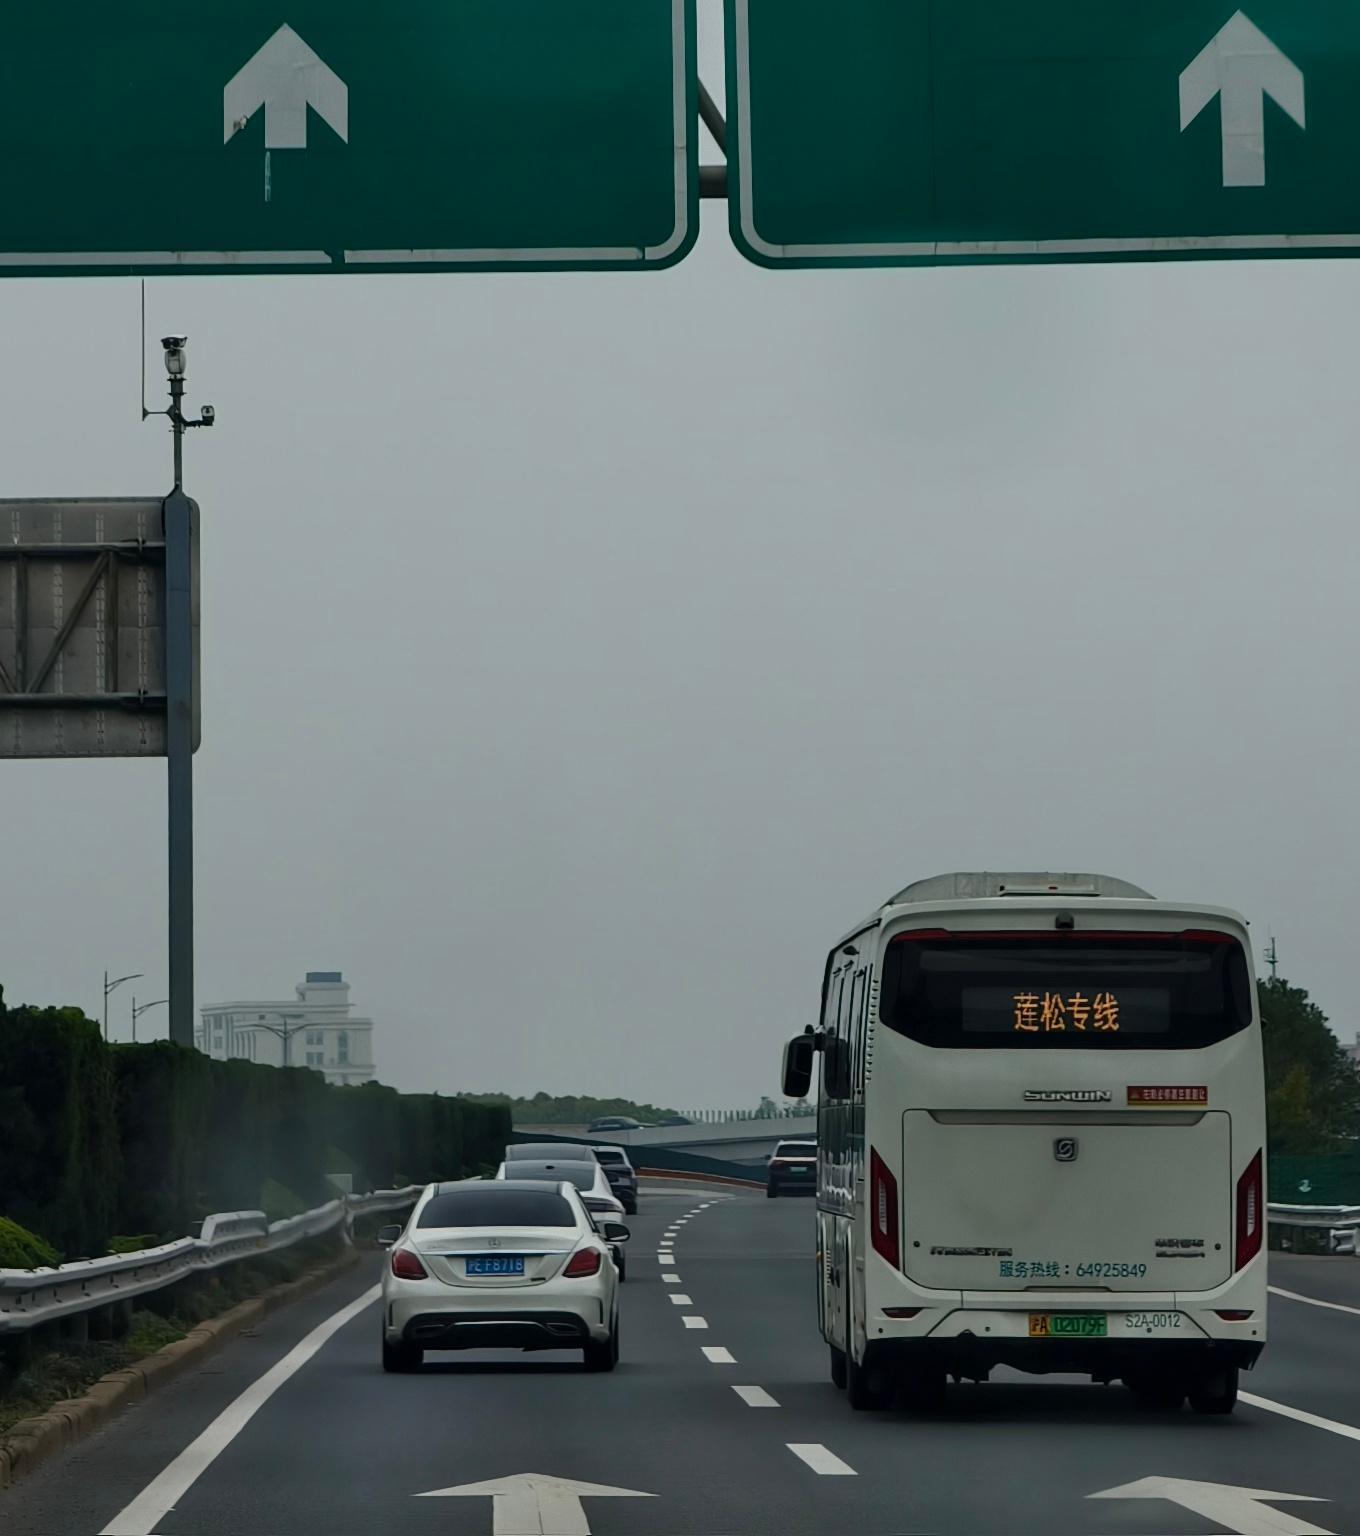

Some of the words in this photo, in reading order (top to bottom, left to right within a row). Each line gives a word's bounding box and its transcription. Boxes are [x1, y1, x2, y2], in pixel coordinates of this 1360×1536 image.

[1013, 992, 1120, 1032] 莲松专线
[1024, 1090, 1112, 1102] SUNWIN
[1126, 1314, 1181, 1328] S2A-0012
